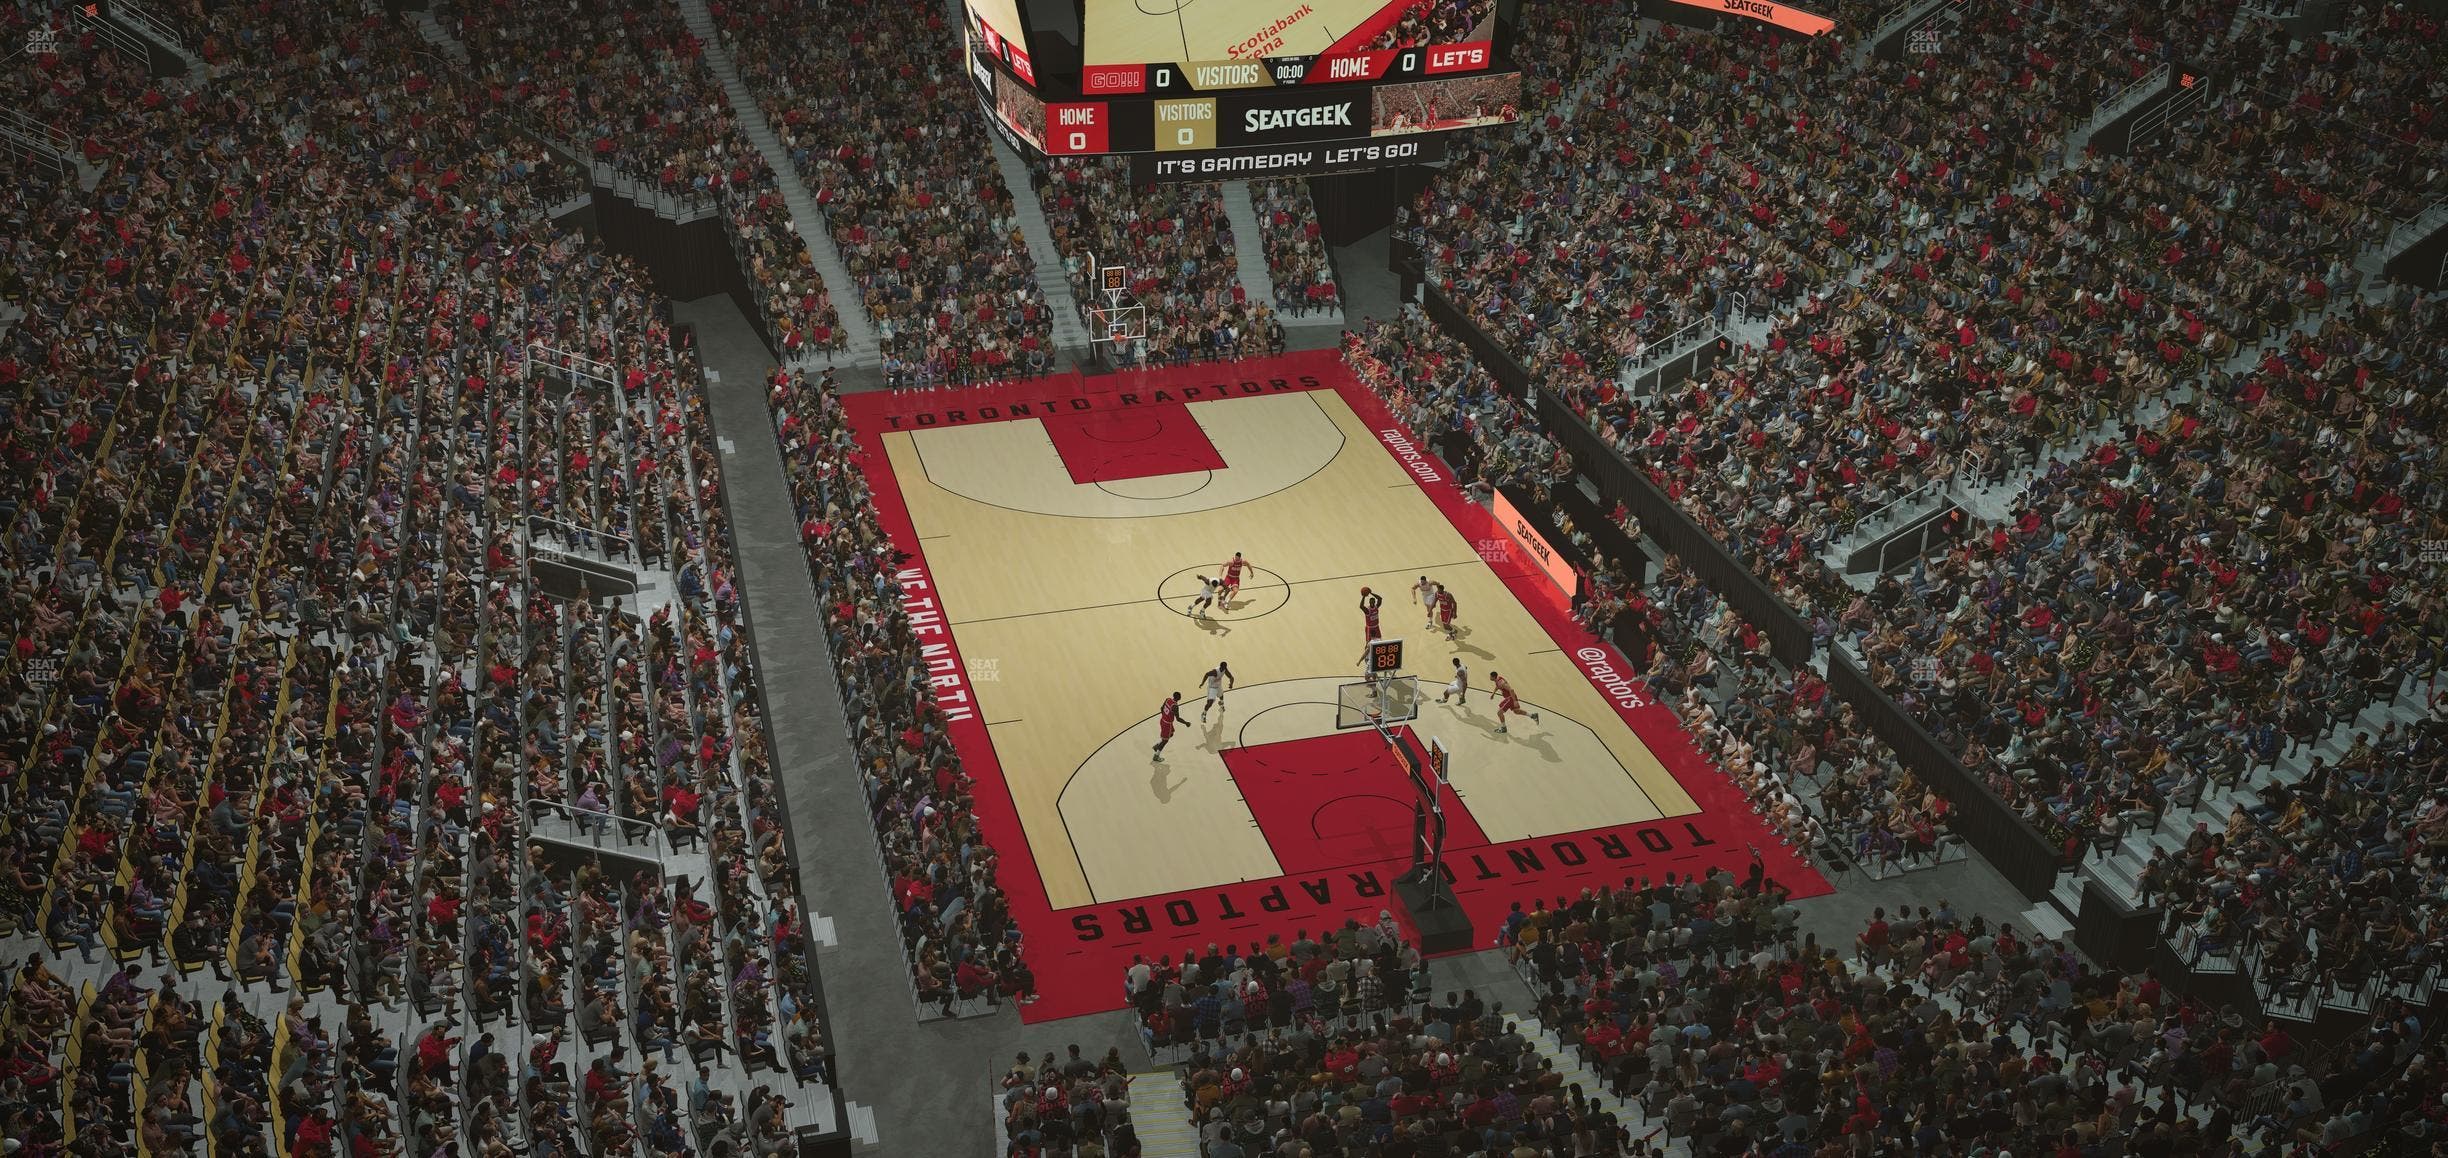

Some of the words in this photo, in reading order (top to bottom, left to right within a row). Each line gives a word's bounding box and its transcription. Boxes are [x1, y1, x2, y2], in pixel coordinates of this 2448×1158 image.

[1724, 0, 1774, 20] SEATGEEK
[1227, 4, 1313, 61] Scotiabank
[1245, 37, 1284, 60] rena
[1091, 72, 1140, 88] GO!!!
[1156, 69, 1170, 88] 0
[1196, 65, 1259, 86] VISITORS
[1330, 56, 1371, 79] HOME
[1402, 53, 1415, 72] 0
[1432, 49, 1483, 68] LET'S
[1276, 64, 1304, 80] 00:00
[1059, 107, 1095, 125] HOME
[1159, 103, 1212, 121] VISITORS
[1245, 102, 1352, 132] SEATGEEK
[1069, 132, 1086, 150] 0
[1177, 128, 1194, 145] 0
[1157, 159, 1196, 175] IT'S
[1201, 152, 1313, 172] GAMEDAY
[1325, 146, 1380, 164] LET'S
[1385, 142, 1418, 159] GO!
[884, 398, 1092, 429] TORONTO
[1119, 376, 1321, 405] RAPTORS
[1380, 428, 1441, 483] raptors.com
[1516, 520, 1552, 567] SEATGEEK
[896, 567, 928, 590] WE
[902, 597, 944, 635] THE
[1576, 646, 1645, 710] @raptors
[1071, 871, 1386, 942] RAPTORS
